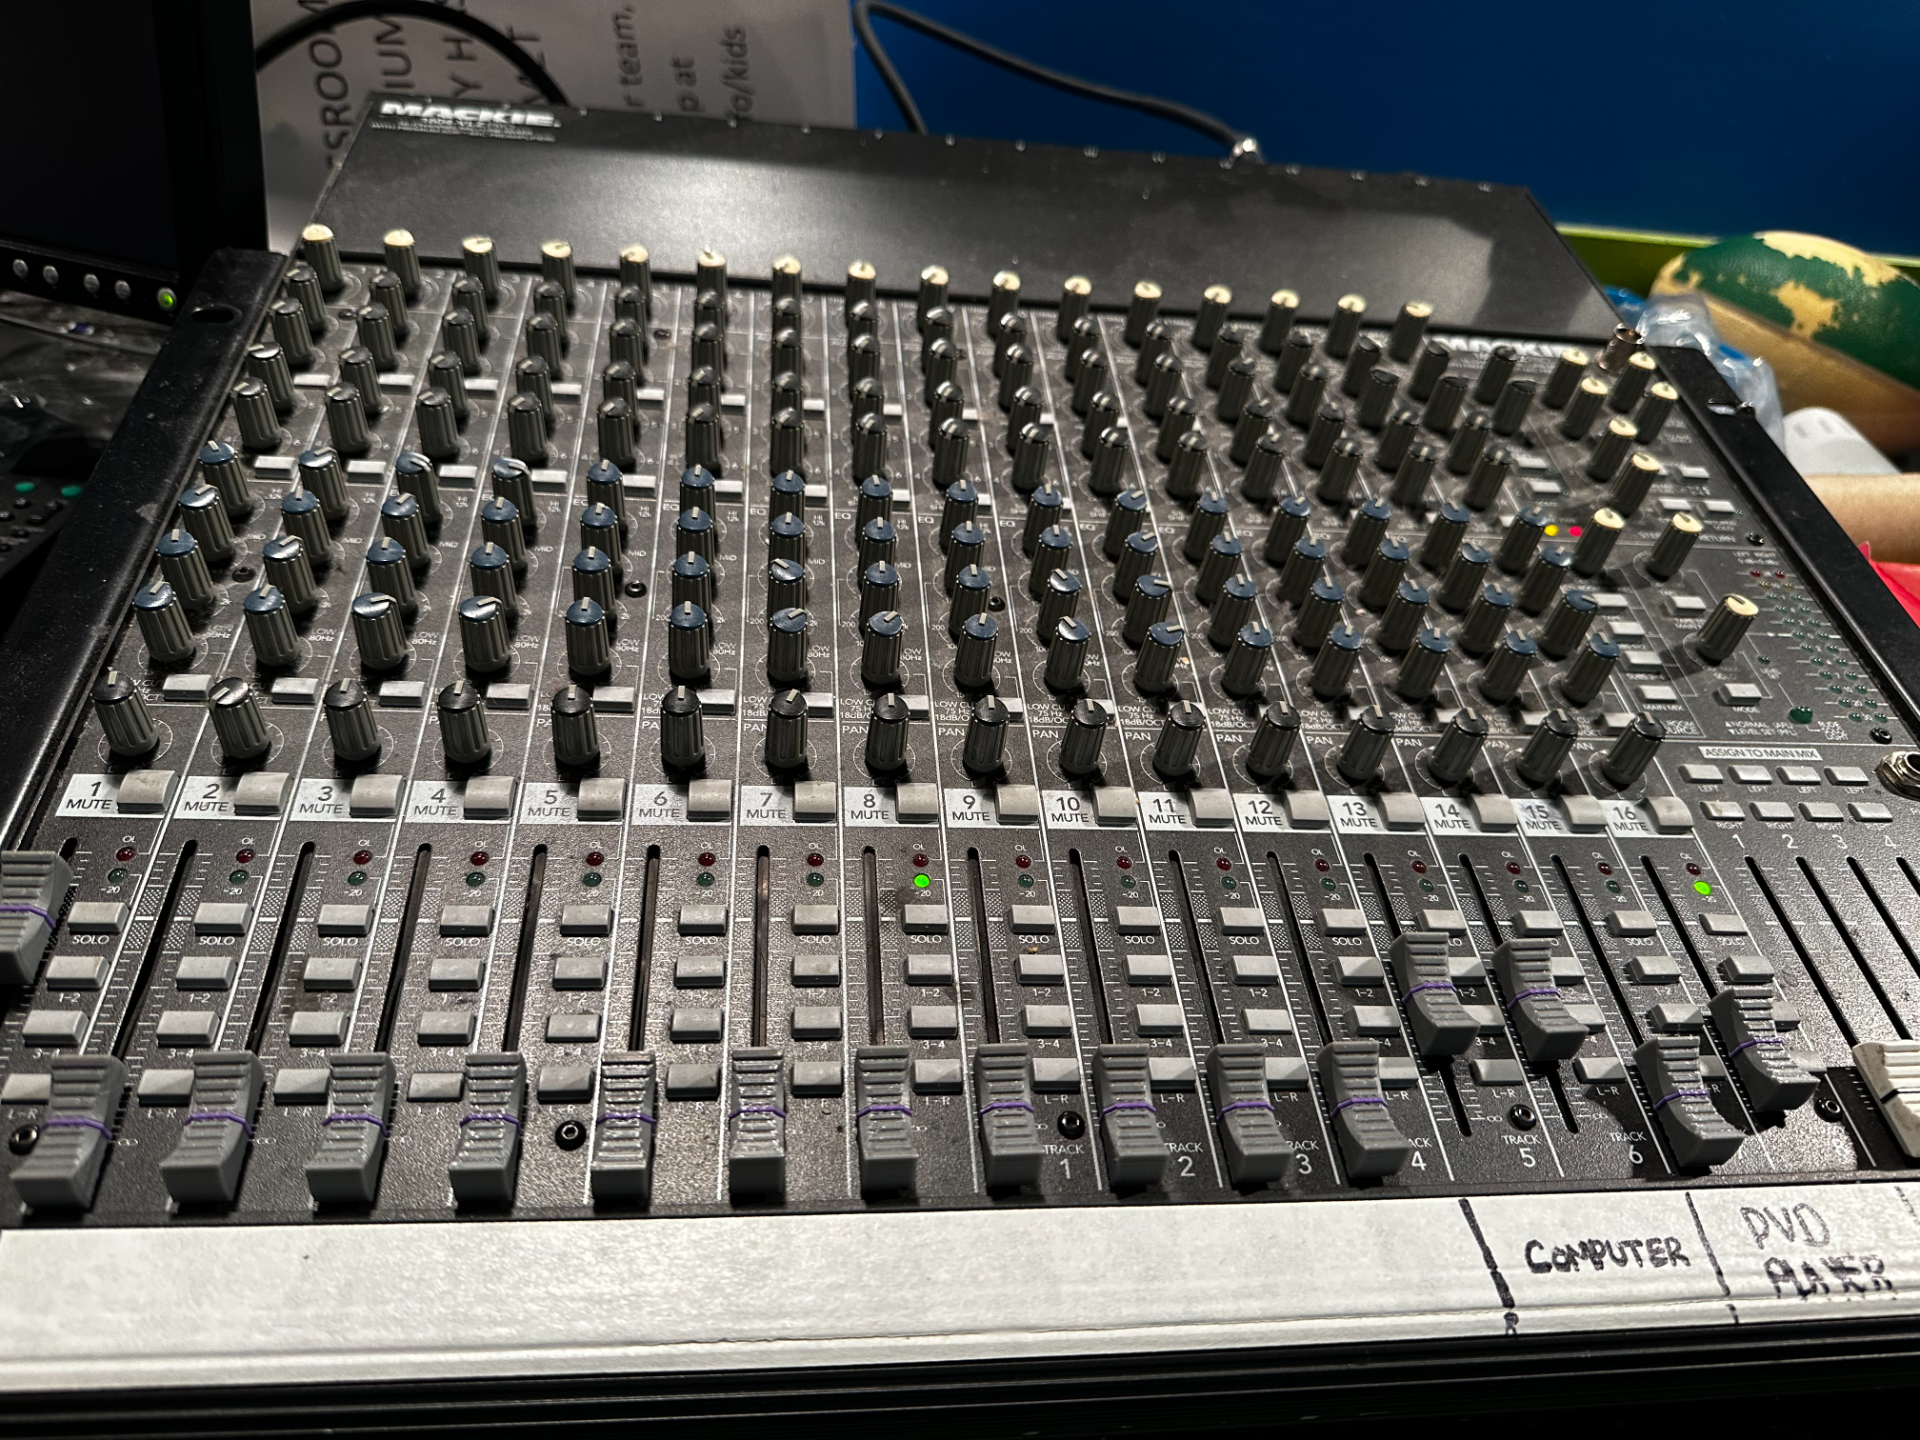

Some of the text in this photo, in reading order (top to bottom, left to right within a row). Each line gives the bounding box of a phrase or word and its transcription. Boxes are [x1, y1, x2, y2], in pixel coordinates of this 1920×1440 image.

[842, 726, 868, 735] PAN
[938, 728, 965, 736] PAN
[1032, 730, 1059, 739] PAN
[1125, 732, 1151, 740] PAN
[1216, 734, 1242, 743] PAN
[1307, 736, 1333, 745] PAN
[1396, 738, 1422, 747] PAN
[1705, 748, 1818, 758] ASSIGN TO MAIN MIX
[90, 782, 102, 797] 1
[202, 784, 220, 799] 2
[318, 786, 333, 801] 3
[431, 788, 447, 803] 4
[544, 790, 558, 805] 5
[654, 791, 667, 806] 6
[760, 792, 773, 807] 7
[66, 799, 112, 810] MUTE
[184, 801, 228, 812] MUTE
[863, 794, 875, 809] 8
[963, 795, 975, 810] 9
[1055, 796, 1080, 811] 10
[1152, 798, 1175, 812] 11
[300, 803, 343, 814] MUTE
[414, 805, 457, 816] MUTE
[528, 807, 570, 817] MUTE
[1248, 800, 1273, 815] 12
[1342, 801, 1367, 816] 13
[1435, 803, 1460, 817] 14
[1526, 804, 1549, 819] 15
[639, 808, 680, 818] MUTE
[746, 809, 786, 819] MUTE
[850, 810, 889, 820] MUTE
[952, 811, 990, 821] MUTE
[1051, 813, 1089, 823] MUTE
[1613, 806, 1637, 820] 16
[1149, 814, 1186, 825] MUTE
[1245, 816, 1282, 827] MUTE
[1340, 817, 1377, 828] MUTE
[1434, 818, 1471, 830] MUTE
[1525, 820, 1561, 831] MUTE
[1612, 821, 1648, 832] MUTE
[1732, 833, 1745, 849] 1
[1781, 834, 1798, 849] 2
[1831, 834, 1848, 850] 3
[1884, 835, 1897, 849] 4
[72, 935, 110, 945] SOLO
[198, 936, 235, 946] SOLO
[322, 936, 359, 946] SOLO
[444, 937, 480, 947] SOLO
[566, 937, 601, 947] SOLO
[685, 936, 718, 945] SOLO
[799, 935, 832, 945] SOLO
[910, 935, 942, 944] SOLO
[1018, 935, 1050, 945] SOLO
[1124, 935, 1155, 945] SOLO
[1229, 936, 1260, 946] SOLO
[1331, 937, 1362, 947] SOLO
[921, 988, 940, 997] 1-2
[1032, 988, 1052, 997] 1-2
[1142, 988, 1162, 997] 1-2
[1250, 988, 1269, 998] 1-2
[1354, 988, 1374, 998] 1-2
[1458, 988, 1478, 998] 1-2
[59, 993, 81, 1003] 1-2
[189, 993, 210, 1003] 1-2
[923, 1040, 946, 1049] 3-4
[1037, 1039, 1060, 1048] 3-4
[1150, 1038, 1173, 1048] 3-4
[1475, 1036, 1496, 1046] 3-4
[167, 1048, 194, 1058] 3-4
[1502, 1134, 1541, 1146] TRACK
[1609, 1131, 1647, 1142] TRACK
[1043, 1144, 1084, 1155] TRACK
[1286, 1140, 1319, 1150] RACK
[1520, 1148, 1536, 1168] 5
[1629, 1145, 1644, 1165] 6
[1295, 1154, 1313, 1175] 3
[1411, 1150, 1427, 1171] 4
[1060, 1158, 1071, 1179] 1
[1177, 1156, 1196, 1177] 2
[1524, 1236, 1690, 1274] COMPUTER
